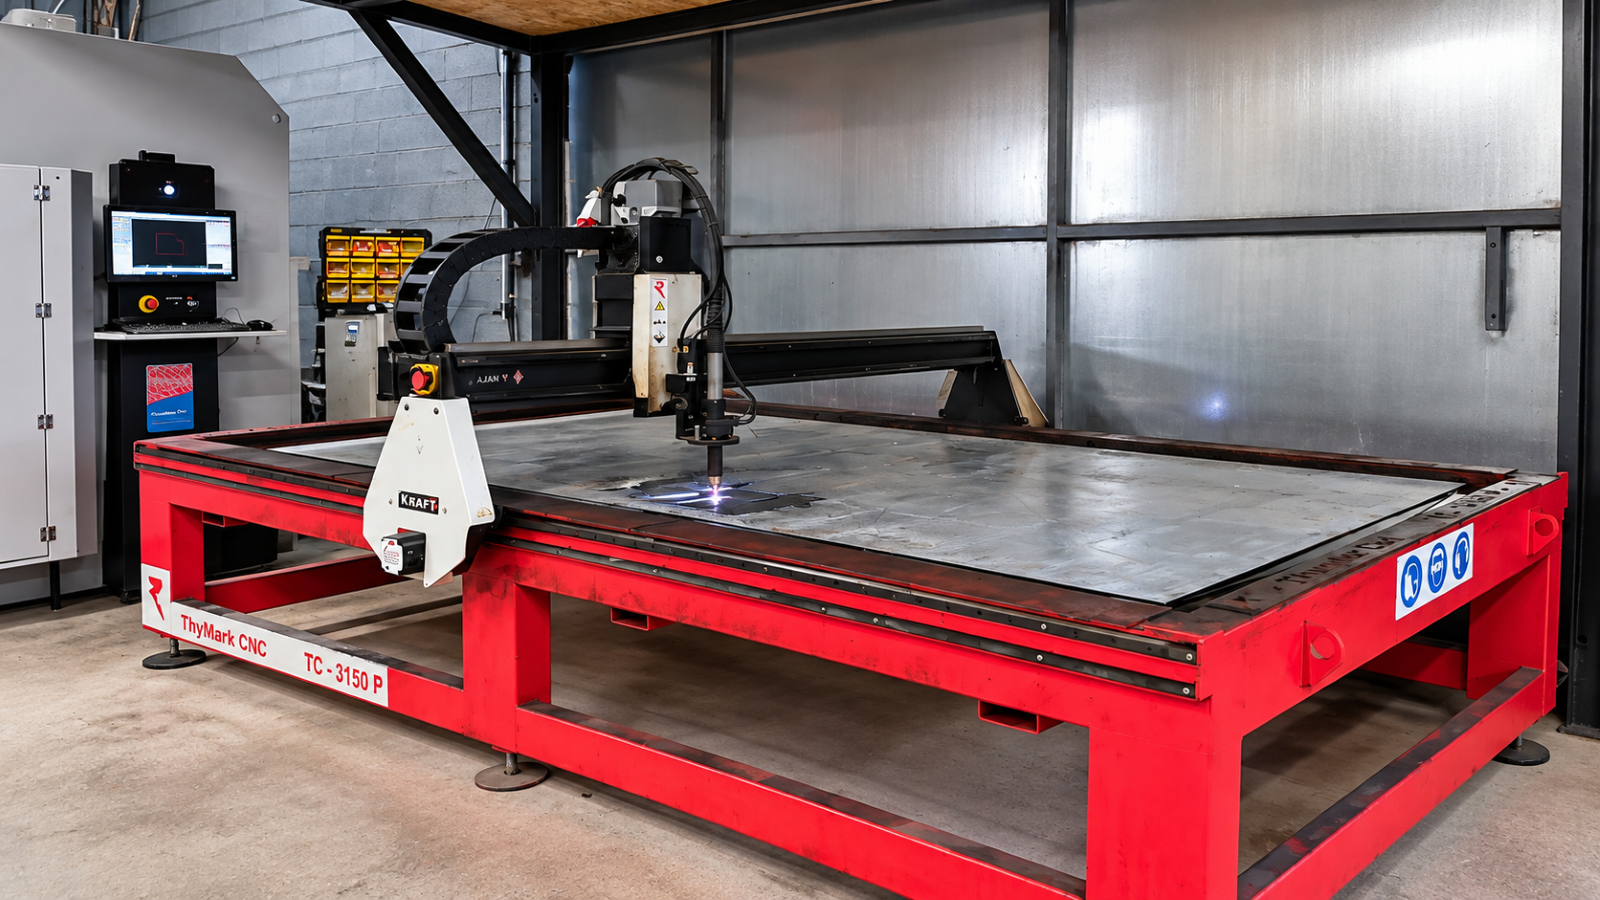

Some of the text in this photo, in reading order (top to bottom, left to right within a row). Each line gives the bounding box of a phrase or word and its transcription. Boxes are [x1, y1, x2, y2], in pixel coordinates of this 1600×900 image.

[476, 375, 499, 384] AJAN
[401, 494, 436, 512] KRAFT
[180, 614, 267, 657] ThyMark CNC
[304, 652, 323, 675] TC
[335, 663, 368, 691] 3150
[373, 674, 383, 694] P
